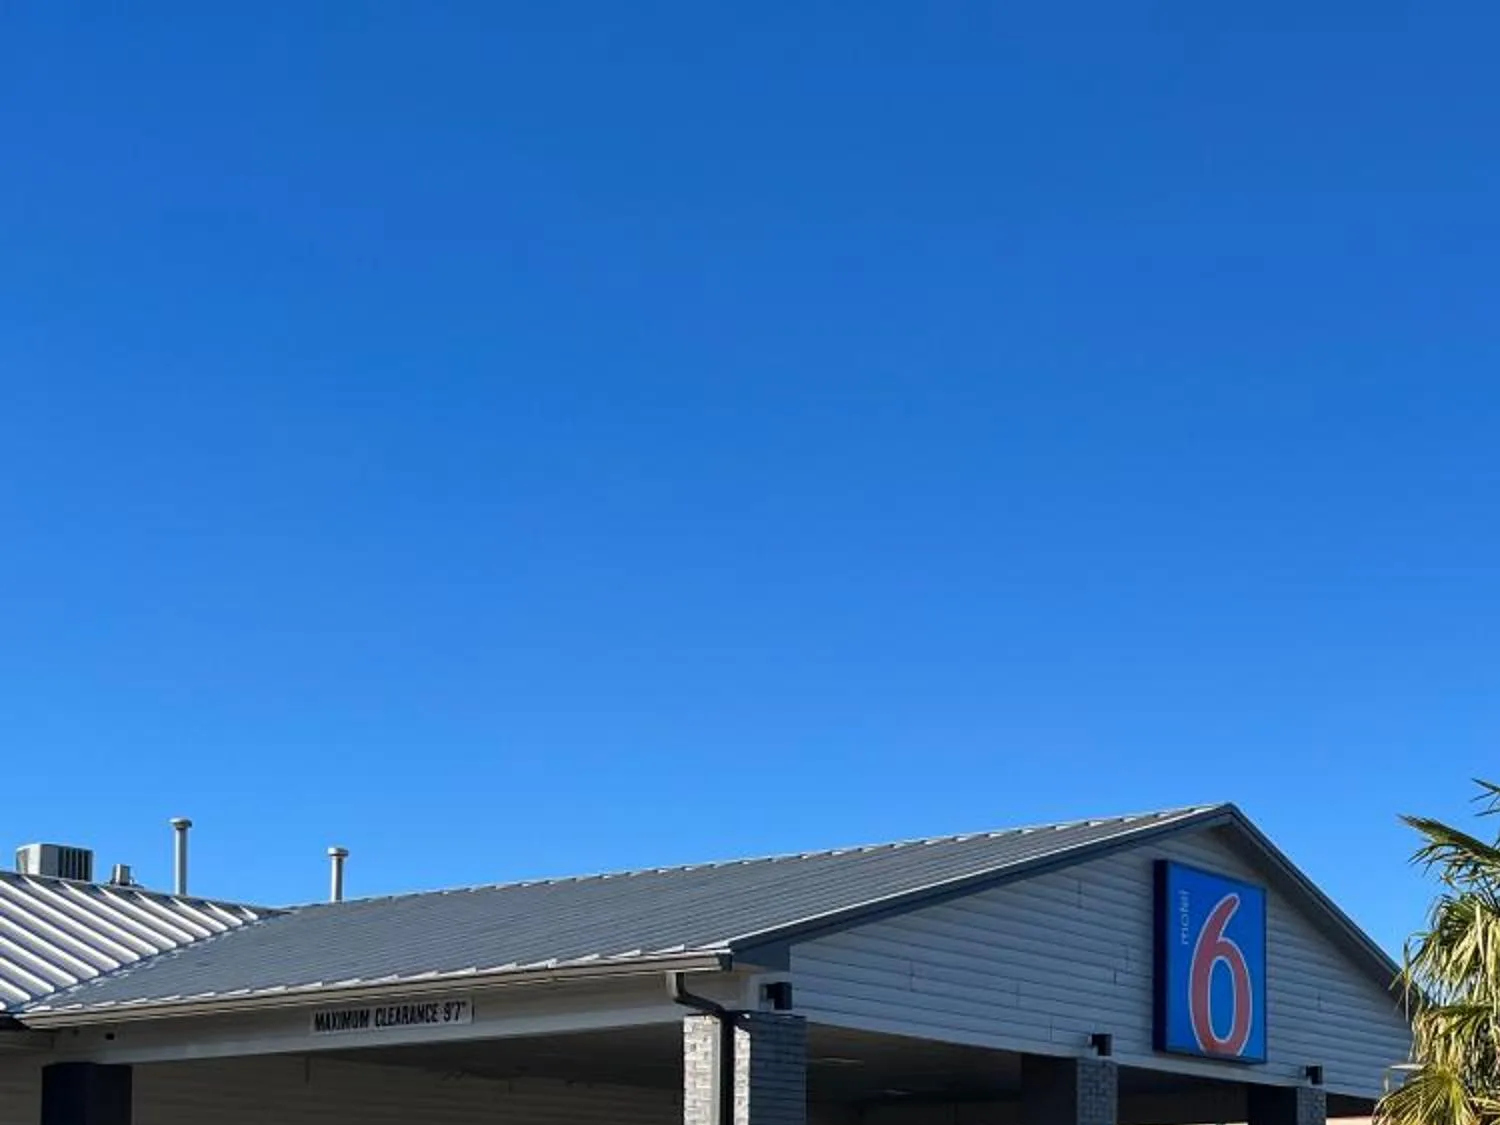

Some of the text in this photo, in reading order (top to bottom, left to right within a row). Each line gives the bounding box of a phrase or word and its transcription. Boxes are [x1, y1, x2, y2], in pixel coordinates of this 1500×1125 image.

[314, 1009, 369, 1032] MAXIMUM
[375, 1003, 437, 1027] CLEARANCE
[1188, 892, 1253, 1057] 6
